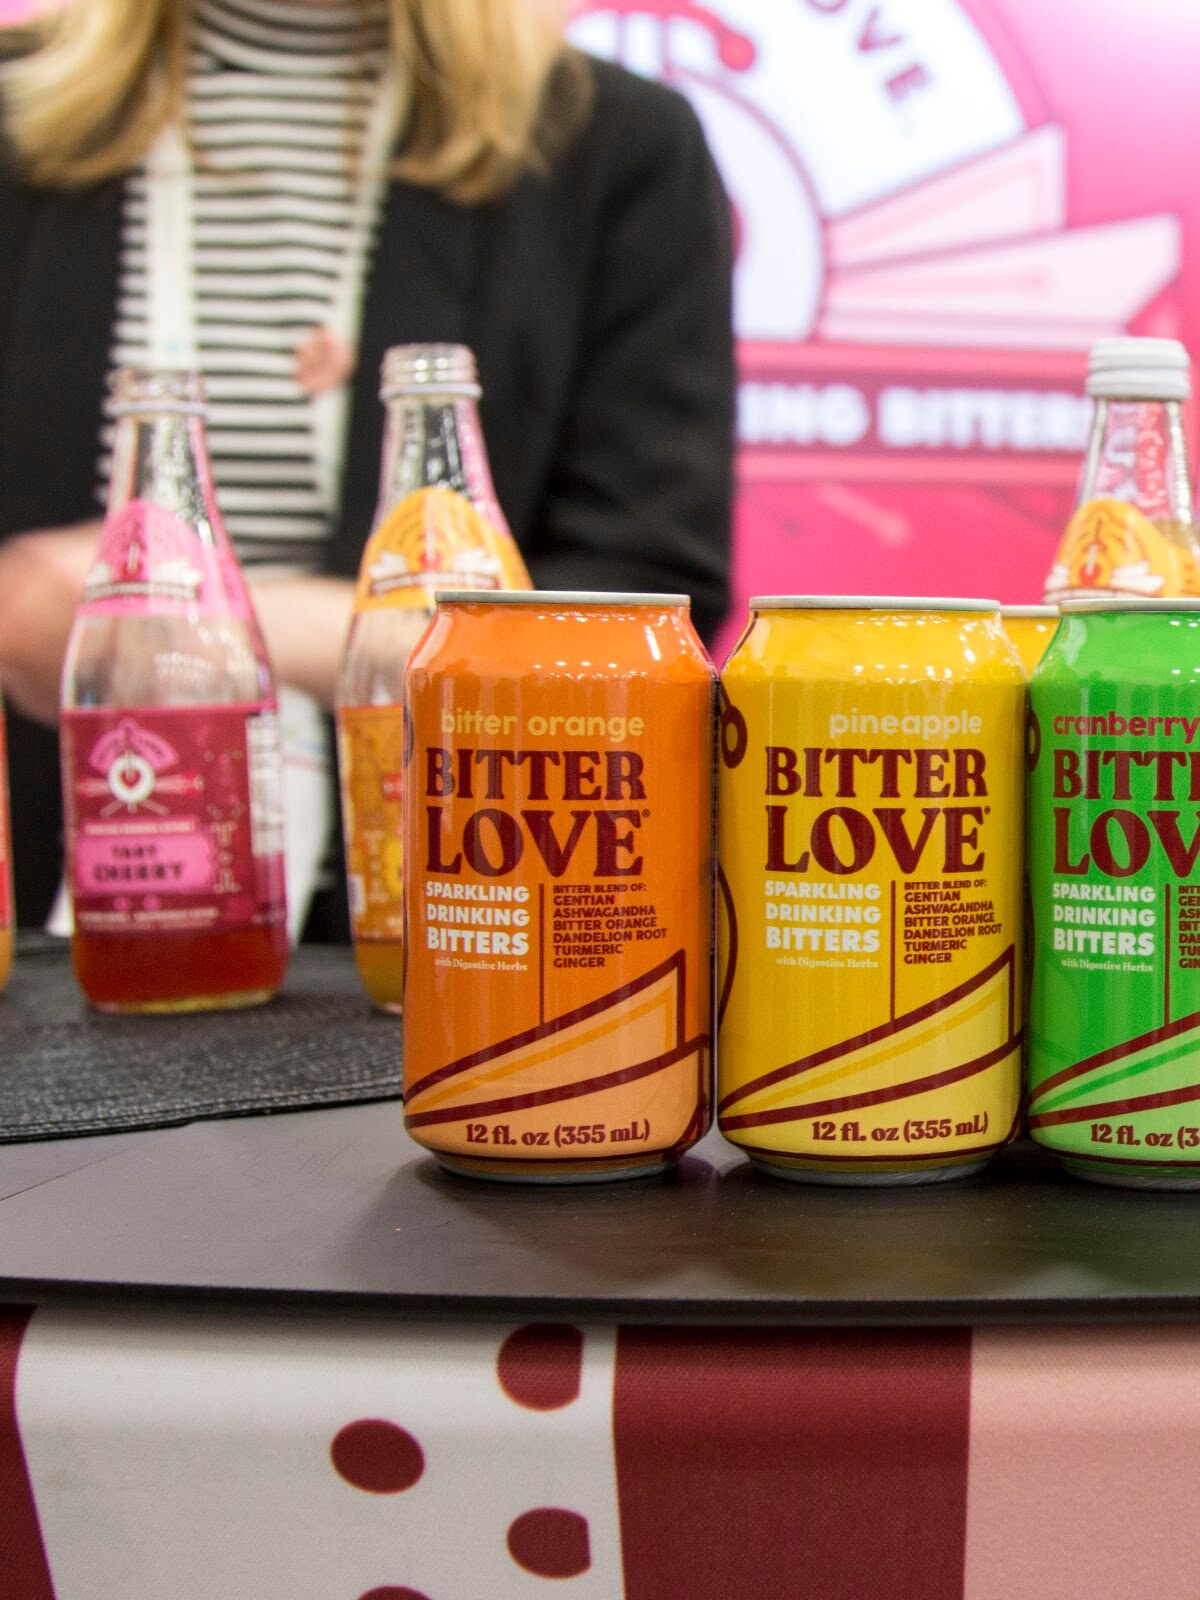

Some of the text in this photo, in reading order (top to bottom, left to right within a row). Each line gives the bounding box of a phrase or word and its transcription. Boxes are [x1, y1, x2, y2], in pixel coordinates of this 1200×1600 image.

[441, 707, 644, 742] bitter orange
[829, 708, 982, 740] pineapple
[1054, 711, 1200, 744] cranberry
[426, 747, 647, 800] BITTER
[765, 746, 988, 798] BITTER
[426, 881, 530, 903] SPARKLING
[553, 885, 590, 894] BITTER
[594, 884, 627, 892] BLEND
[765, 880, 880, 900] SPARKLING
[904, 882, 939, 890] BITTER
[943, 880, 971, 889] BLEND
[1053, 882, 1156, 903] SPARKLING
[553, 895, 614, 906] GENTIAN
[905, 891, 960, 902] GENTIAN
[427, 904, 530, 926] DRINKING
[553, 906, 656, 918] ASHWAGANDHA
[766, 903, 880, 924] DRINKING
[904, 901, 994, 915] ASHWAGANDHA
[1054, 905, 1156, 926] DRINKING
[553, 917, 657, 930] BITTER ORANGE
[905, 913, 994, 927] BITTER ORANGE
[427, 927, 529, 955] BITTERS
[553, 928, 667, 943] DANDELION ROOT
[766, 926, 880, 953] BITTERS
[904, 923, 1002, 939] DANDELION ROOT
[553, 944, 623, 955] TURMERIC
[904, 940, 967, 952] TURMERIC
[1054, 928, 1155, 956] BITTERS
[553, 957, 605, 968] GINGER
[776, 957, 878, 968] with Digestive Herbs
[904, 953, 951, 964] GINGER
[1061, 959, 1153, 972] with Digestive Herbs
[466, 1119, 650, 1146] 12 fl. oz (355 mL)
[813, 1112, 989, 1143] 12 fl. oz (355 mL)
[1090, 1124, 1112, 1143] 12
[1117, 1126, 1141, 1145] fl.
[1144, 1131, 1173, 1147] oz
